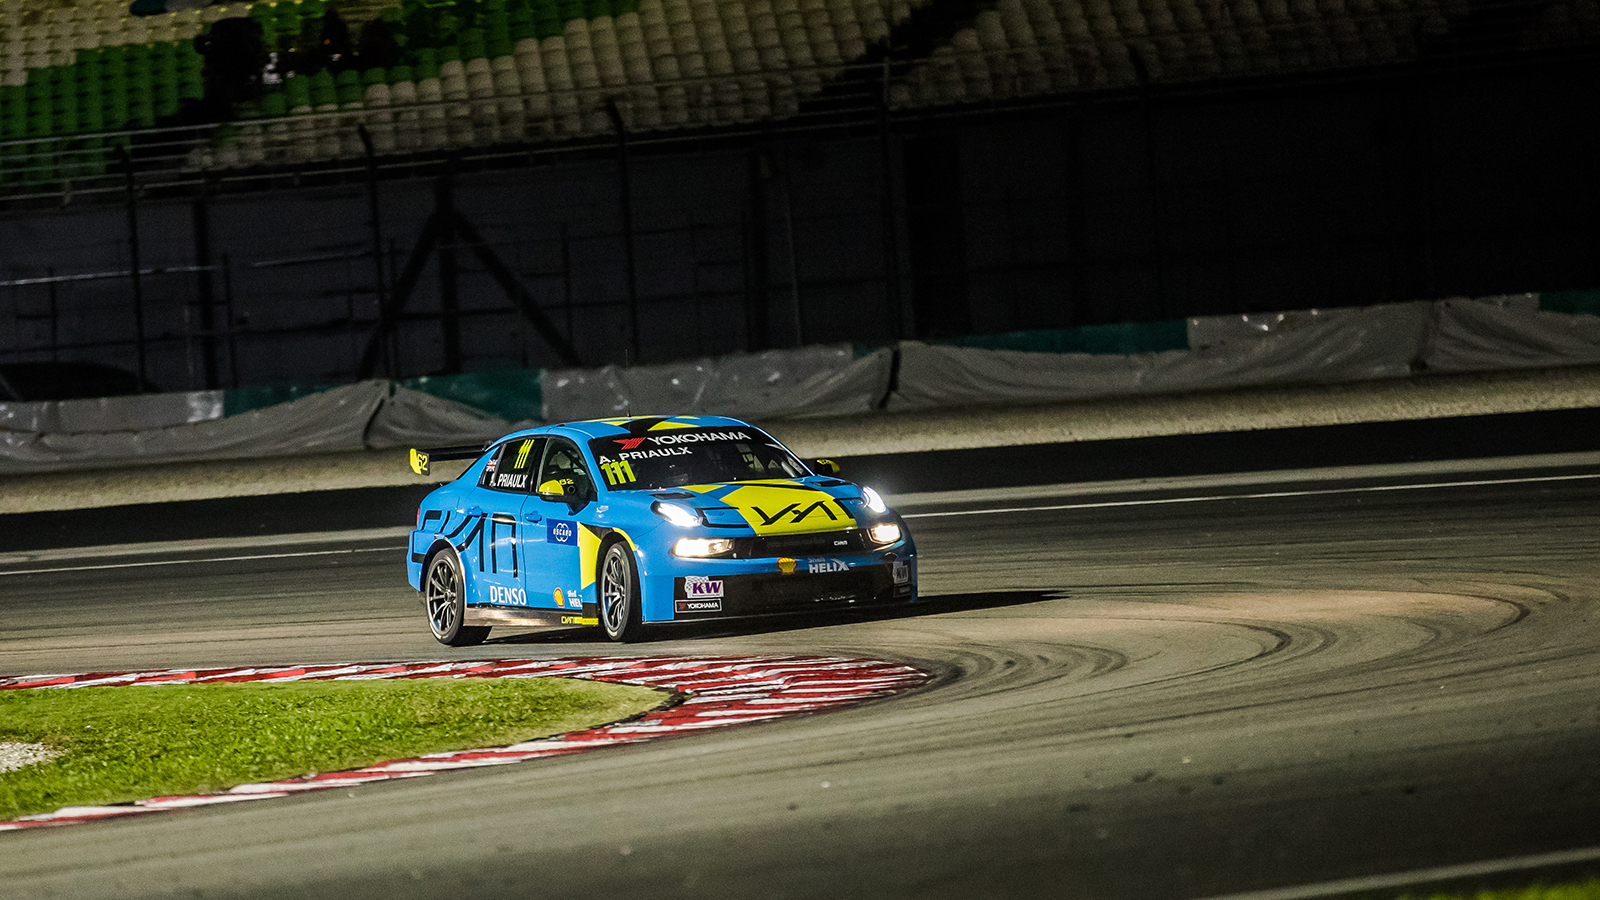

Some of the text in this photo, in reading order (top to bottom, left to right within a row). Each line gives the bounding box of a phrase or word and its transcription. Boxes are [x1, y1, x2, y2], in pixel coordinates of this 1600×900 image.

[647, 431, 751, 446] YOKOHAMA
[514, 438, 535, 469] 111
[599, 446, 693, 465] A. PRIAULX
[497, 473, 529, 488] PRIAULX
[601, 460, 637, 486] 111
[809, 560, 850, 574] HELIX
[692, 581, 722, 594] KW
[490, 586, 527, 606] DENSO
[687, 602, 719, 610] YOKOHAMA
